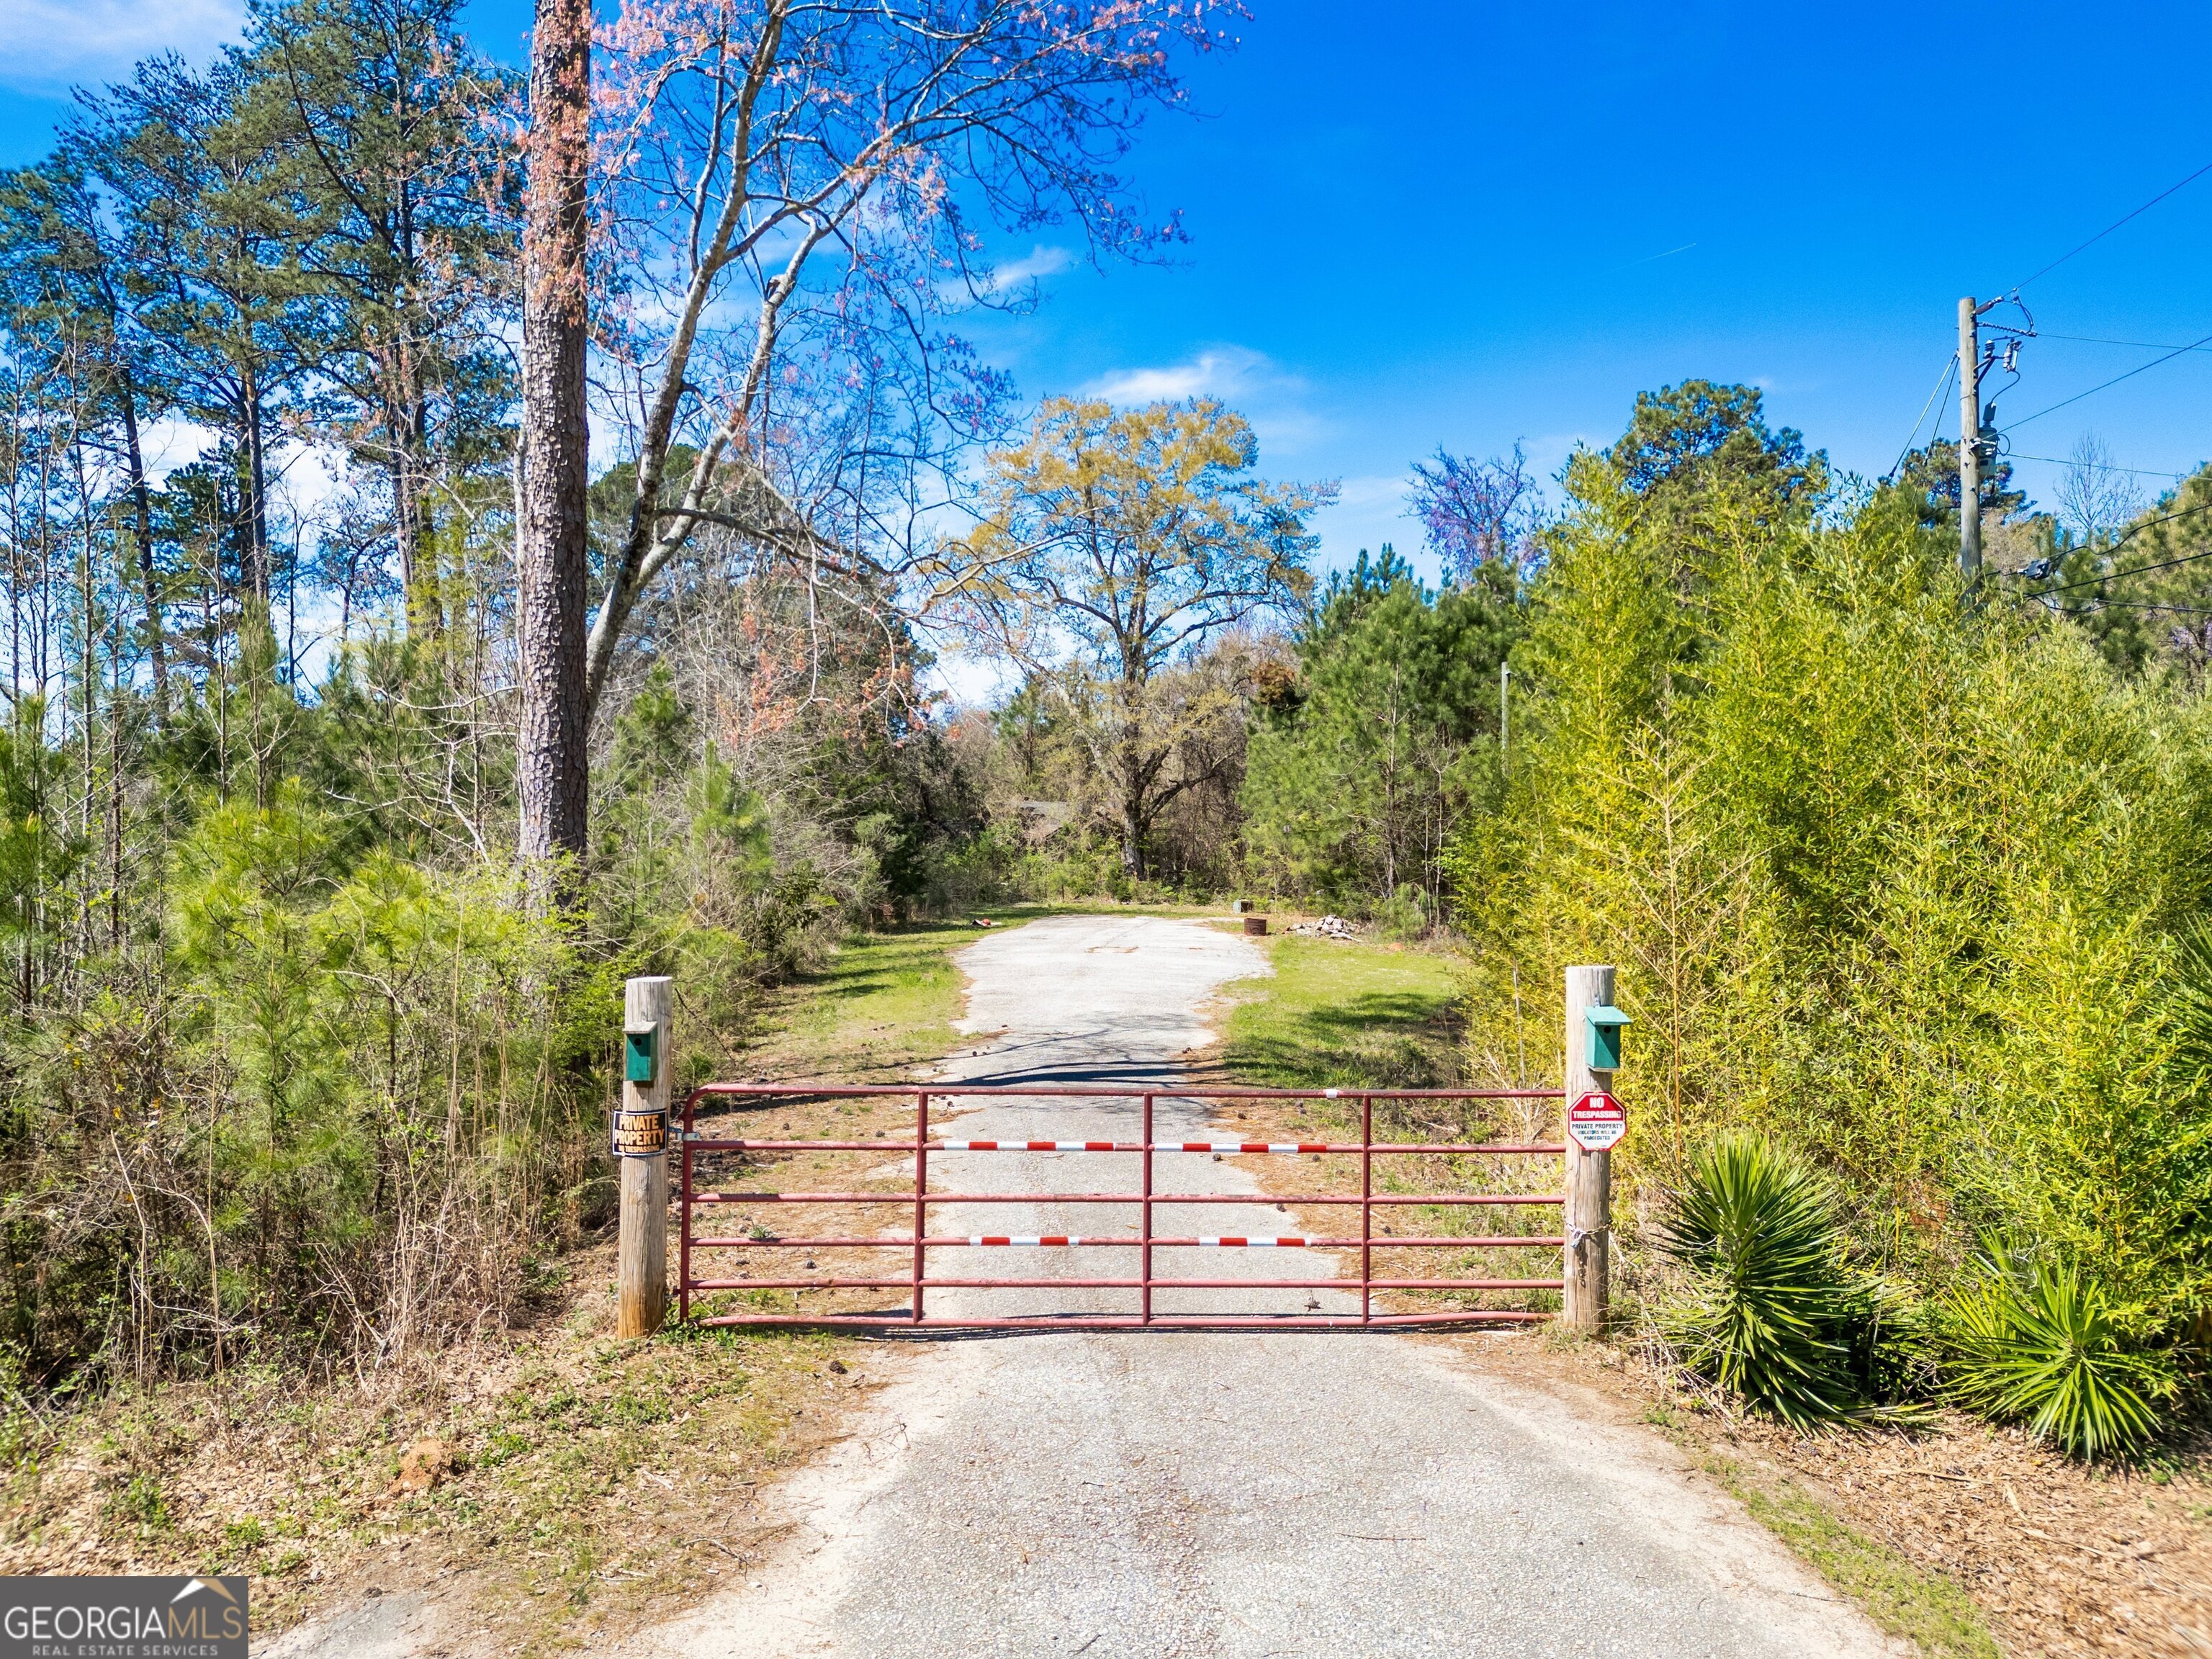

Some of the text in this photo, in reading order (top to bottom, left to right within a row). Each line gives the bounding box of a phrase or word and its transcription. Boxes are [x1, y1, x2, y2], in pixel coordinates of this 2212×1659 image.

[1589, 1097, 1604, 1108] NO
[1573, 1110, 1622, 1119] TRESPASSING
[619, 1114, 659, 1130] PRIVATE
[614, 1128, 665, 1146] PROPERTY
